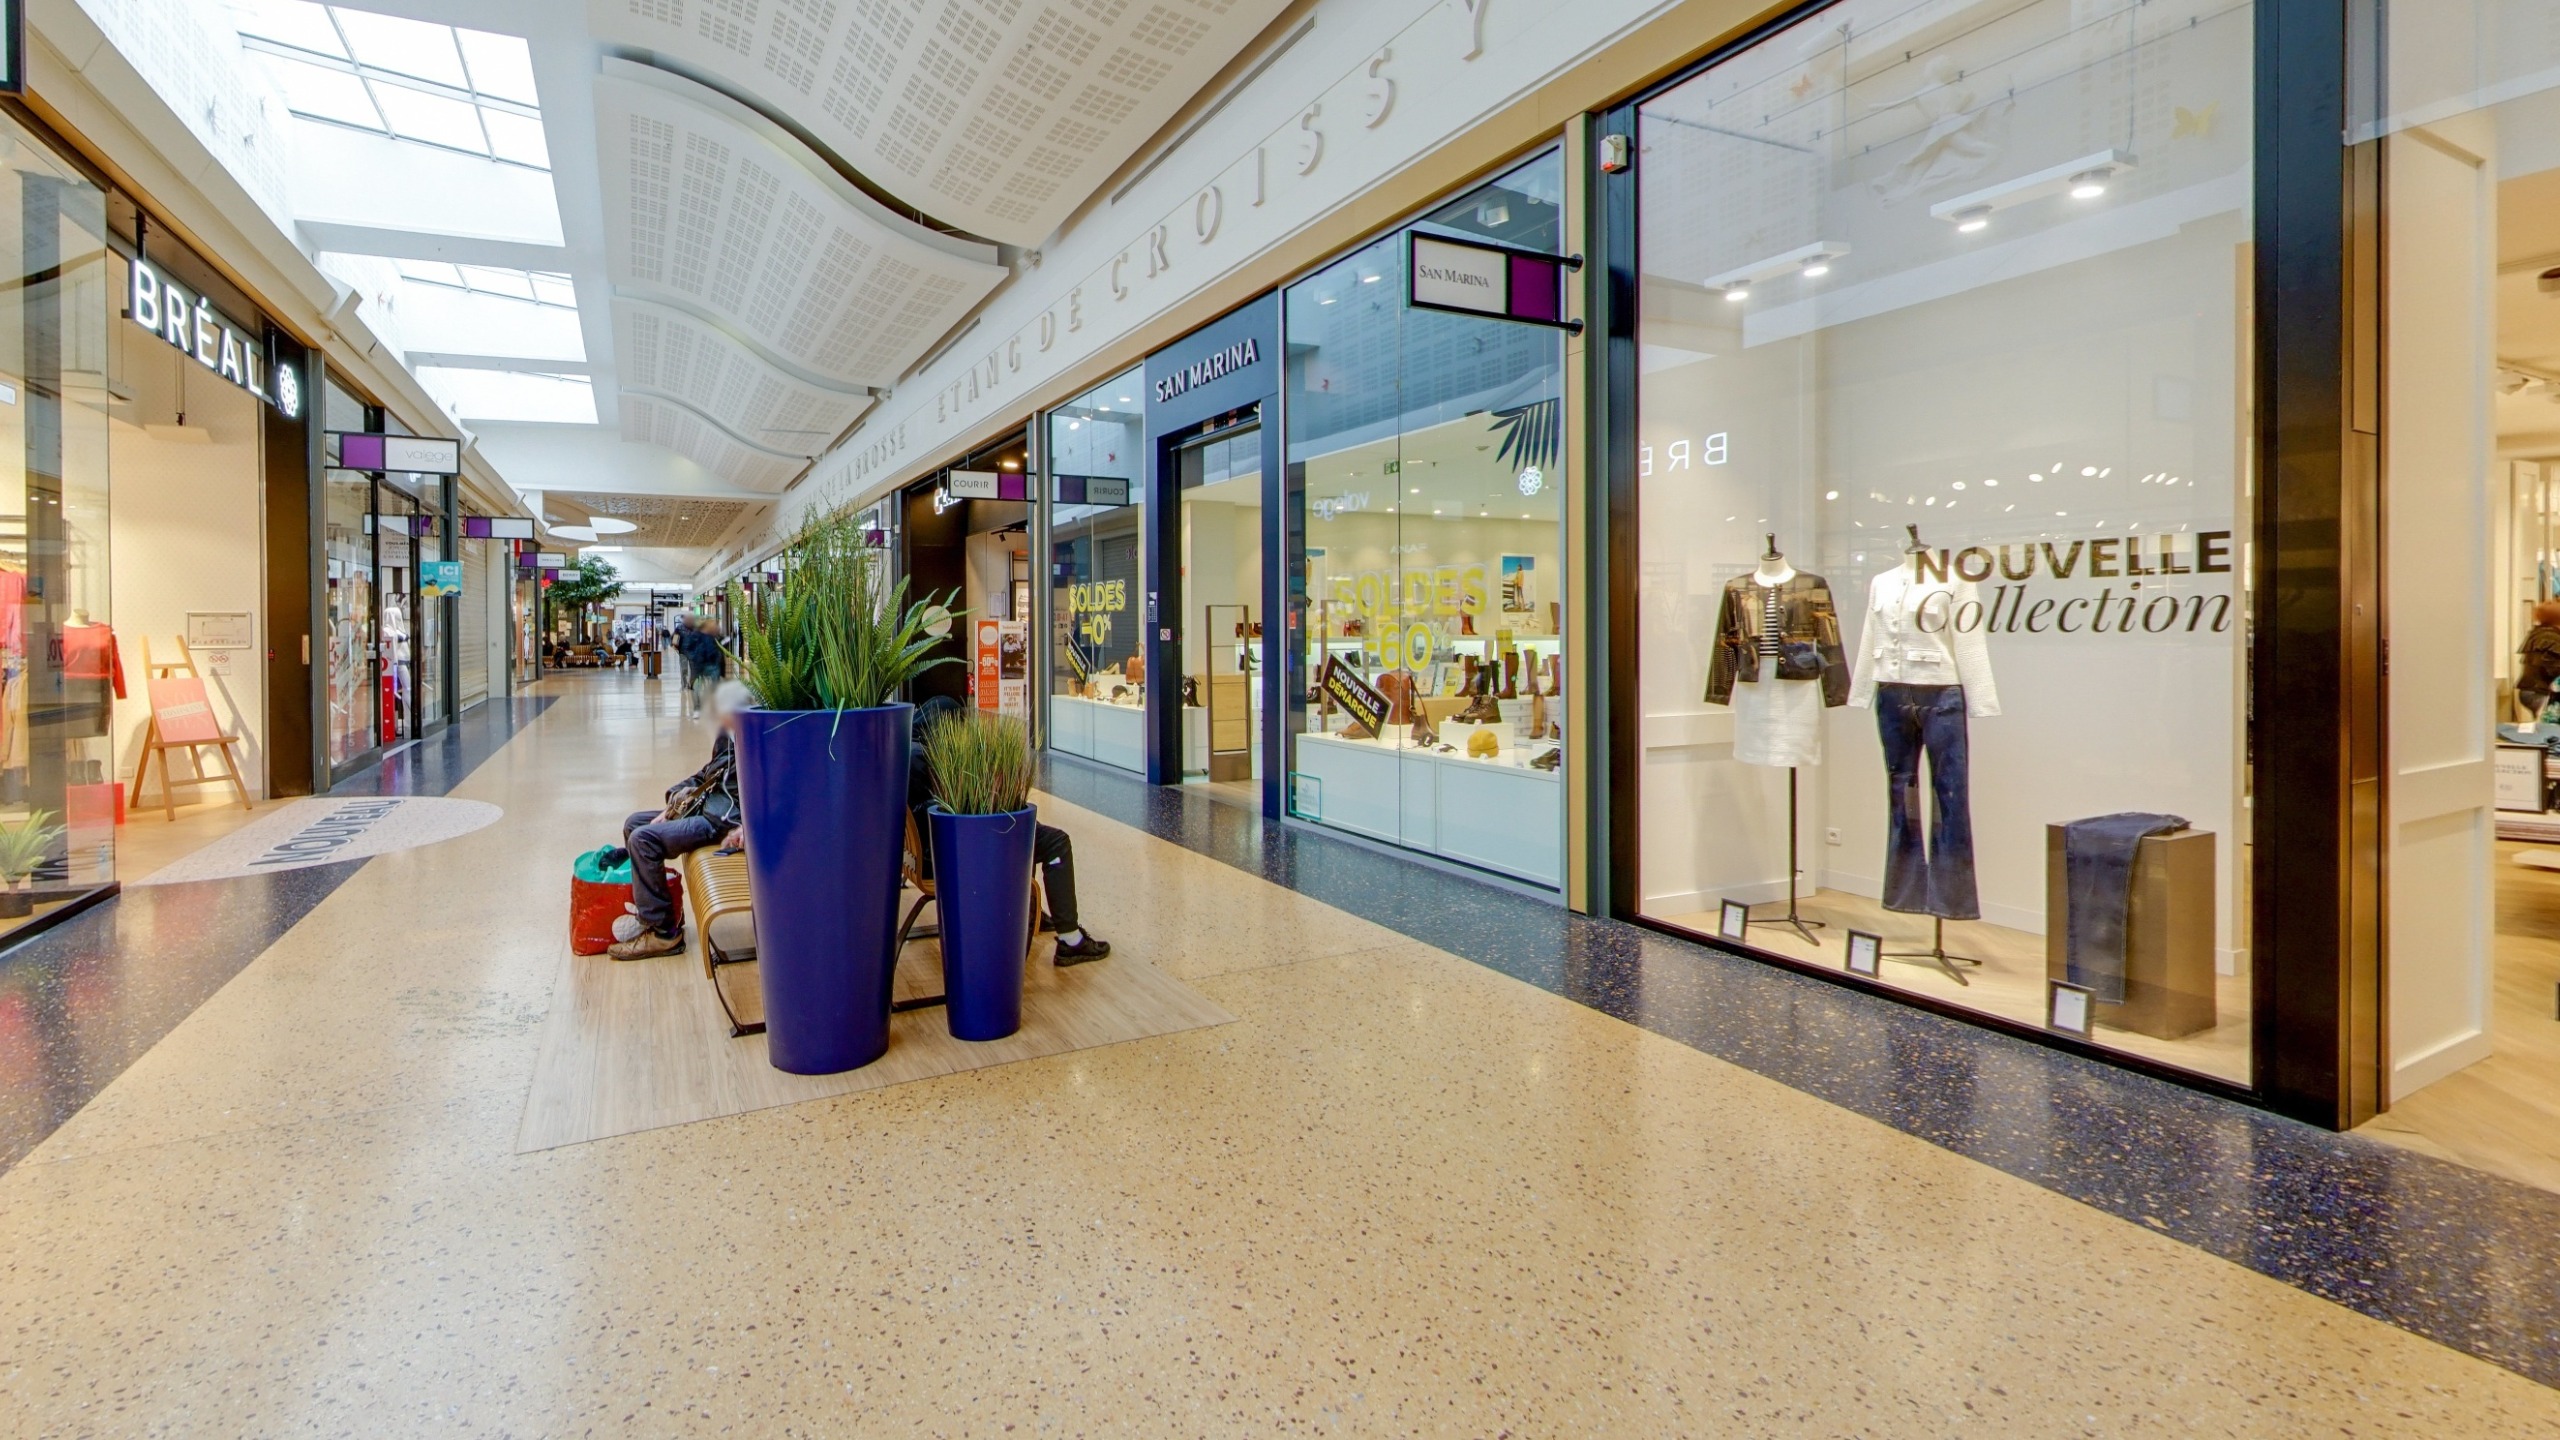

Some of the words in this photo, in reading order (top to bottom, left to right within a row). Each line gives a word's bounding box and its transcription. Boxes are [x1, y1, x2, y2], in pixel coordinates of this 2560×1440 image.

[937, 335, 1021, 424] ETANG
[1039, 287, 1083, 353] DE
[1110, 0, 1488, 301] CROISSY
[1419, 264, 1442, 281] SAN
[1444, 269, 1490, 288] MARINA
[131, 259, 263, 396] BRÉAL
[1155, 369, 1188, 403] SAN
[1190, 338, 1259, 389] MARINA
[952, 478, 989, 490] COURIR
[438, 565, 459, 576] ICI
[1914, 530, 2232, 585] NOUVELLE
[1069, 579, 1126, 613] SOLDES
[1334, 562, 1490, 618] SOLDES
[1914, 581, 2232, 634] Collection
[1362, 620, 1452, 673] -60%
[1328, 676, 1377, 729] DÉMARQUE
[1332, 665, 1380, 715] NOUVELLE
[243, 799, 405, 868] NOUVEAU
